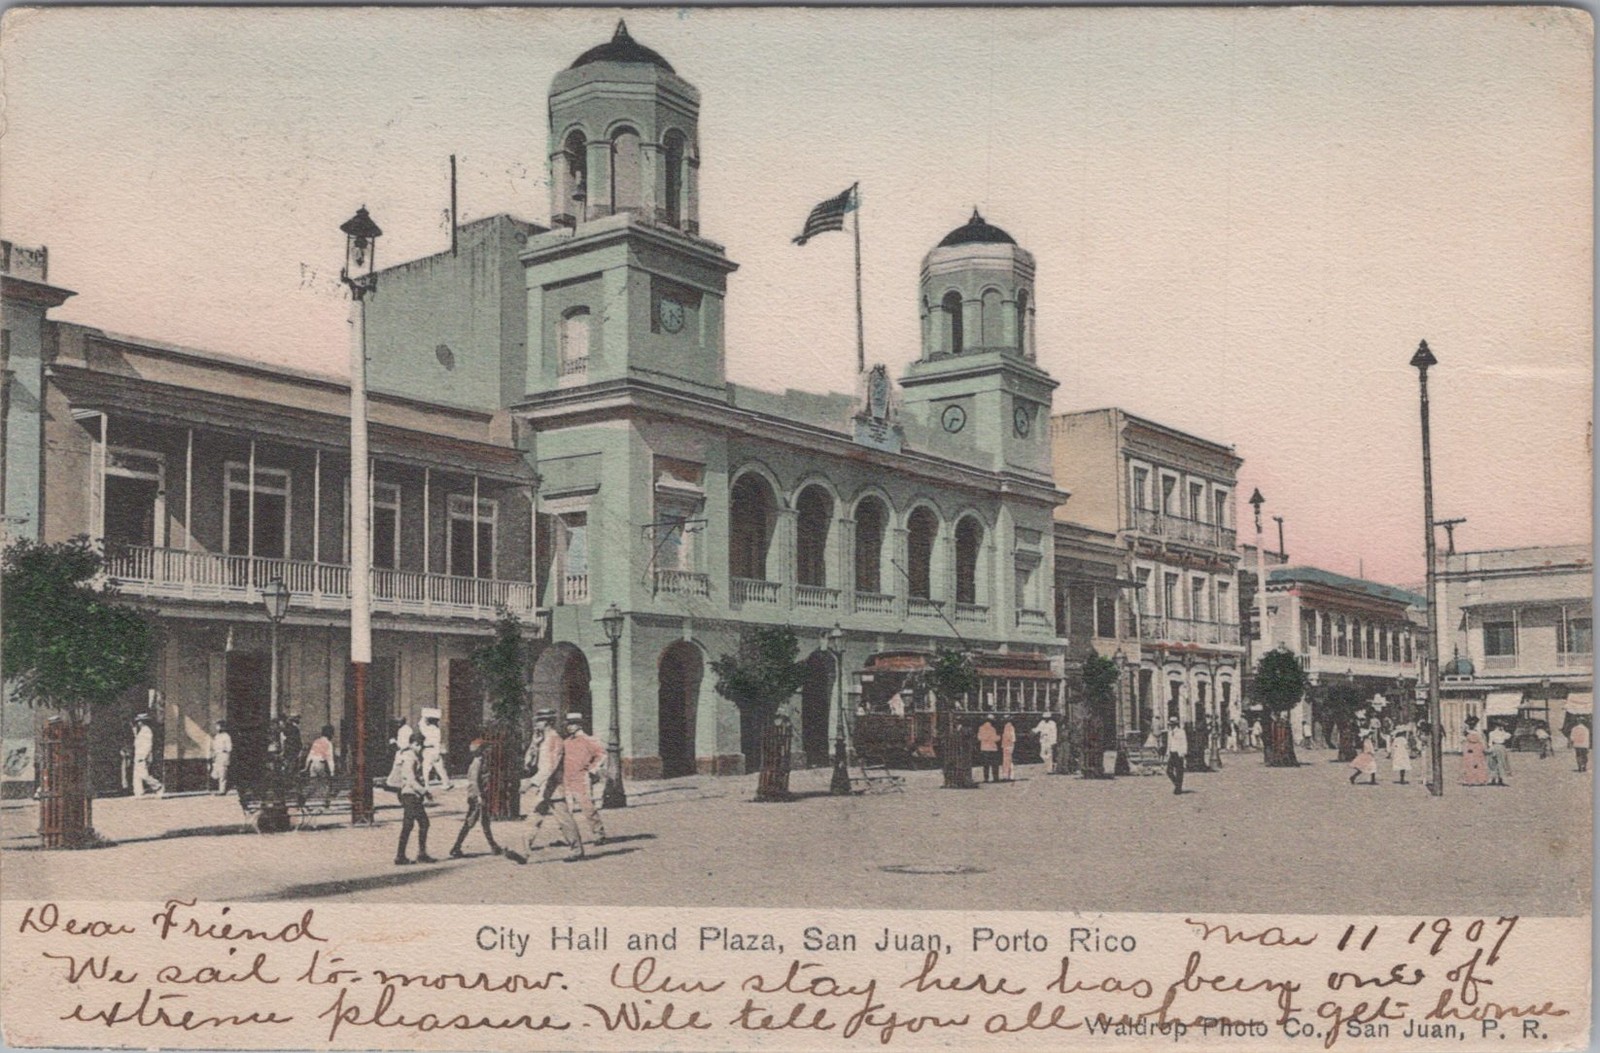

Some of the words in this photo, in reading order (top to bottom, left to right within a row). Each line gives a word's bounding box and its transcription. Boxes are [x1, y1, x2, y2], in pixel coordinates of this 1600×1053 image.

[20, 903, 136, 935] Dear
[153, 897, 328, 942] Friend
[1337, 924, 1379, 951] 11
[1408, 916, 1519, 965] 1907
[42, 952, 138, 983] We
[157, 948, 279, 984] sail
[741, 959, 876, 1038] stay
[900, 950, 1024, 995] here
[1047, 957, 1154, 998] has
[1446, 948, 1494, 1006] of
[60, 990, 293, 1030] extreme
[585, 1000, 712, 1031] Will
[729, 999, 836, 1031] tell
[860, 1003, 970, 1044] you
[985, 1001, 1083, 1032] all
[1316, 996, 1410, 1050] get
[1425, 989, 1570, 1021] home
